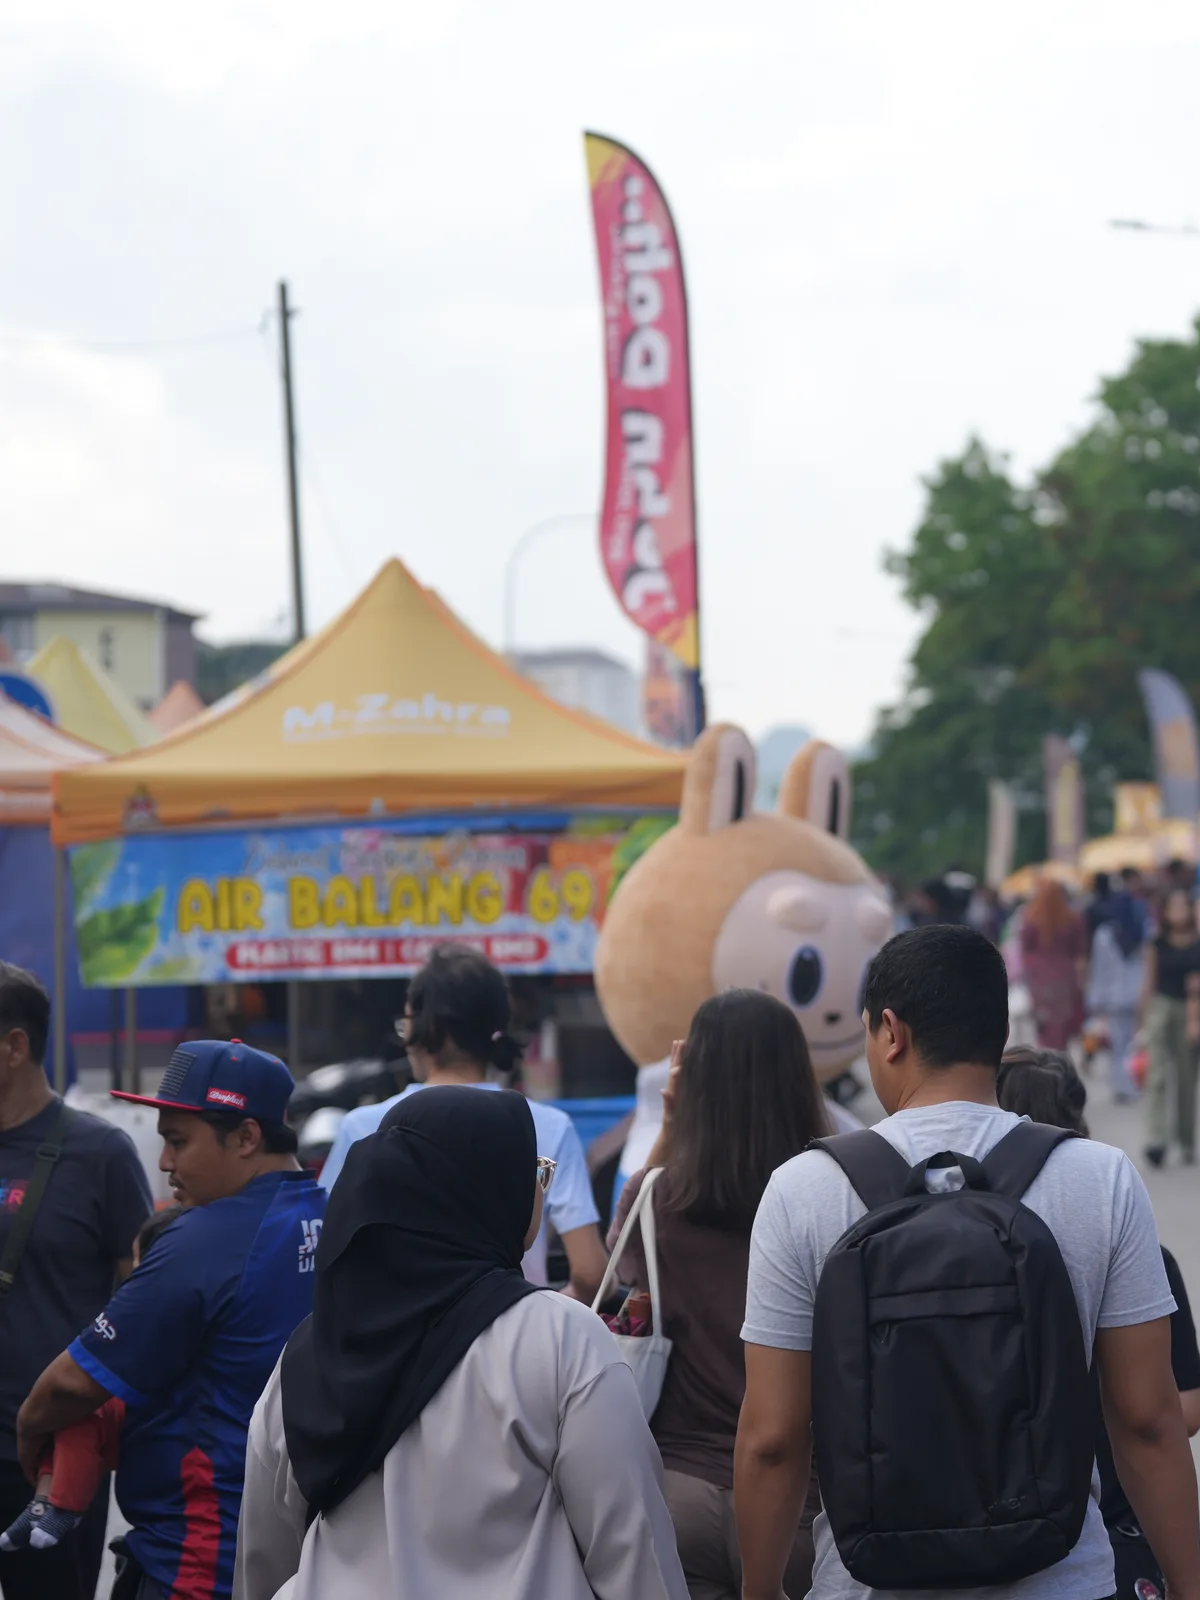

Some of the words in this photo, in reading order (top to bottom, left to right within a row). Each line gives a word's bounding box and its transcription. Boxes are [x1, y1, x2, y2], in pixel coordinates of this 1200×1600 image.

[283, 691, 511, 730] M-Zahra
[177, 875, 265, 933] AIR
[287, 871, 504, 930] BALANG
[528, 867, 594, 925] 69
